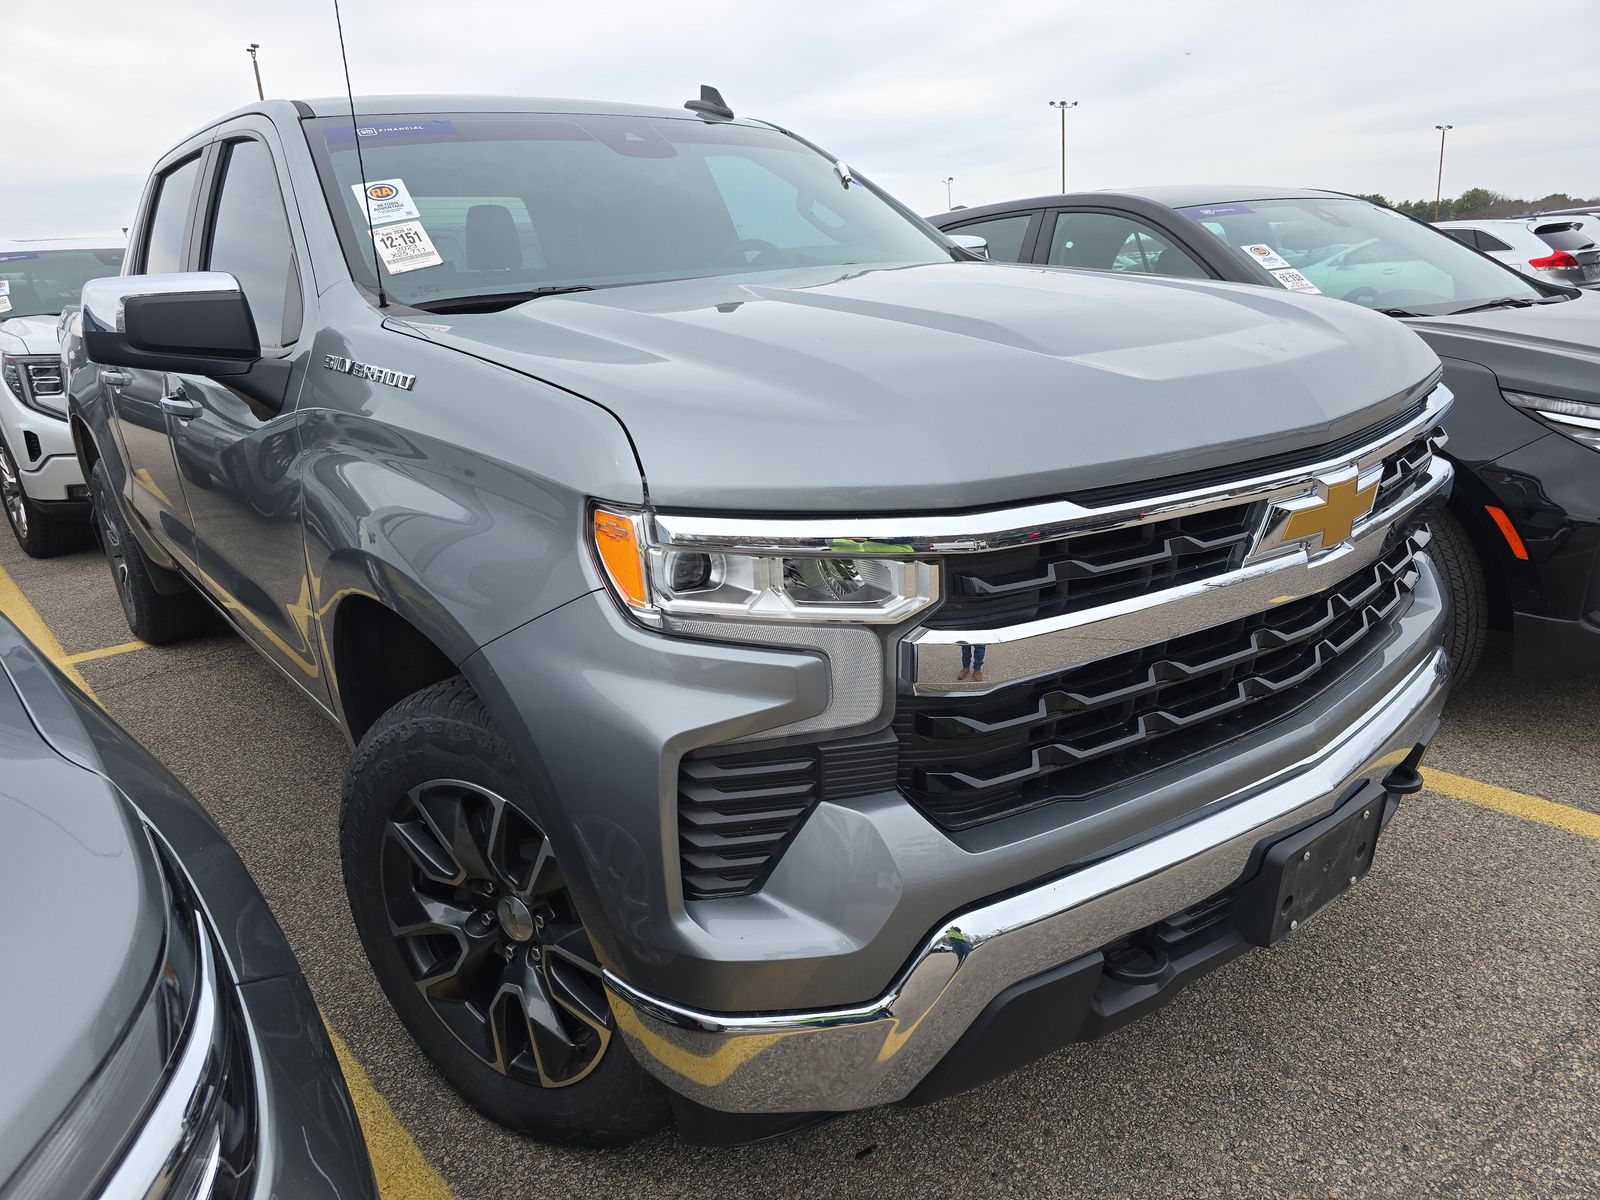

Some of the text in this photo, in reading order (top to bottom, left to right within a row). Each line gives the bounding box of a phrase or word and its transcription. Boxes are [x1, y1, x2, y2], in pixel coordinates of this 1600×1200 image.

[370, 186, 394, 198] RA
[380, 230, 423, 249] 12:151
[323, 354, 416, 391] SILVERADO
